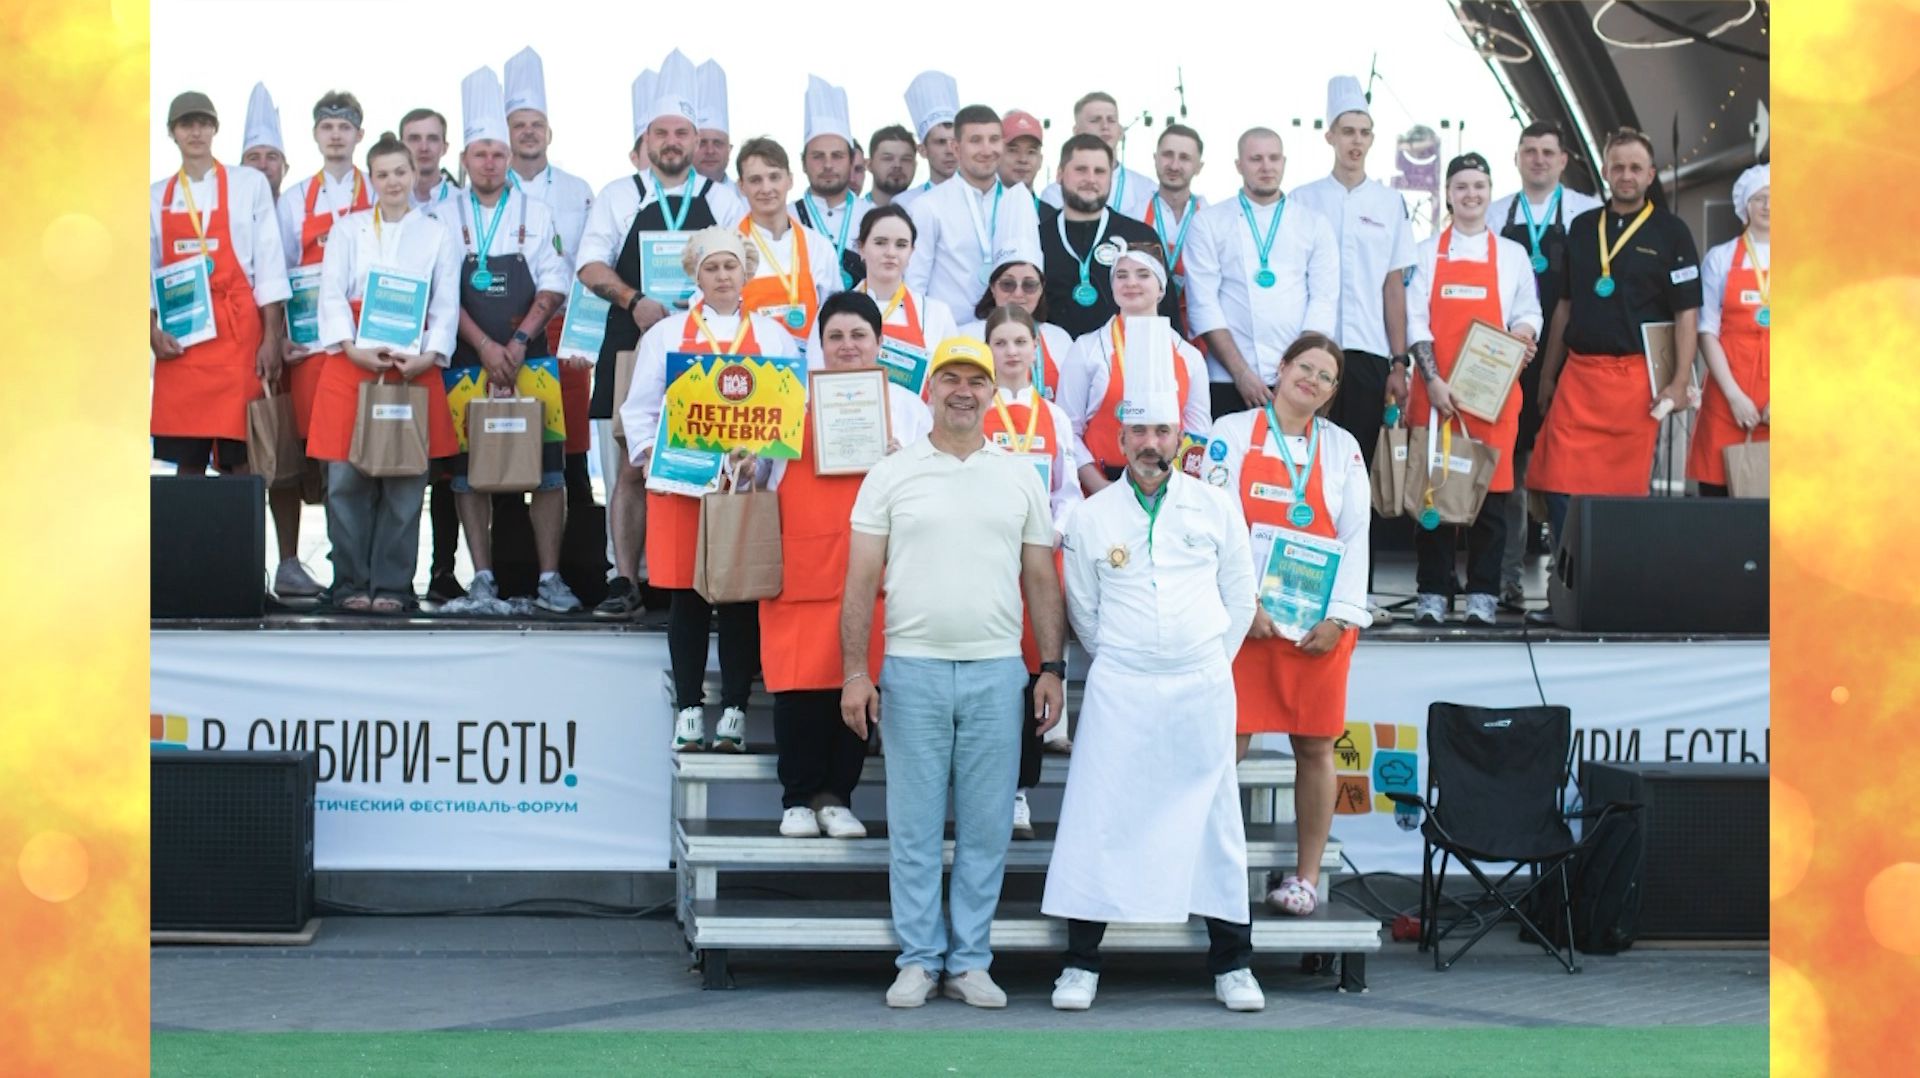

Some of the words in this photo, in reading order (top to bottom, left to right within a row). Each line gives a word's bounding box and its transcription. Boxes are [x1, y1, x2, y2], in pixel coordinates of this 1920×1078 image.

[687, 404, 782, 424] ЛЕТНЯЯ
[687, 420, 781, 440] ПУТЕВКА
[314, 799, 404, 812] ТИЧЕСКИЙ
[410, 800, 578, 813] ФЕСТИВАЛЬ-ФОРУМ
